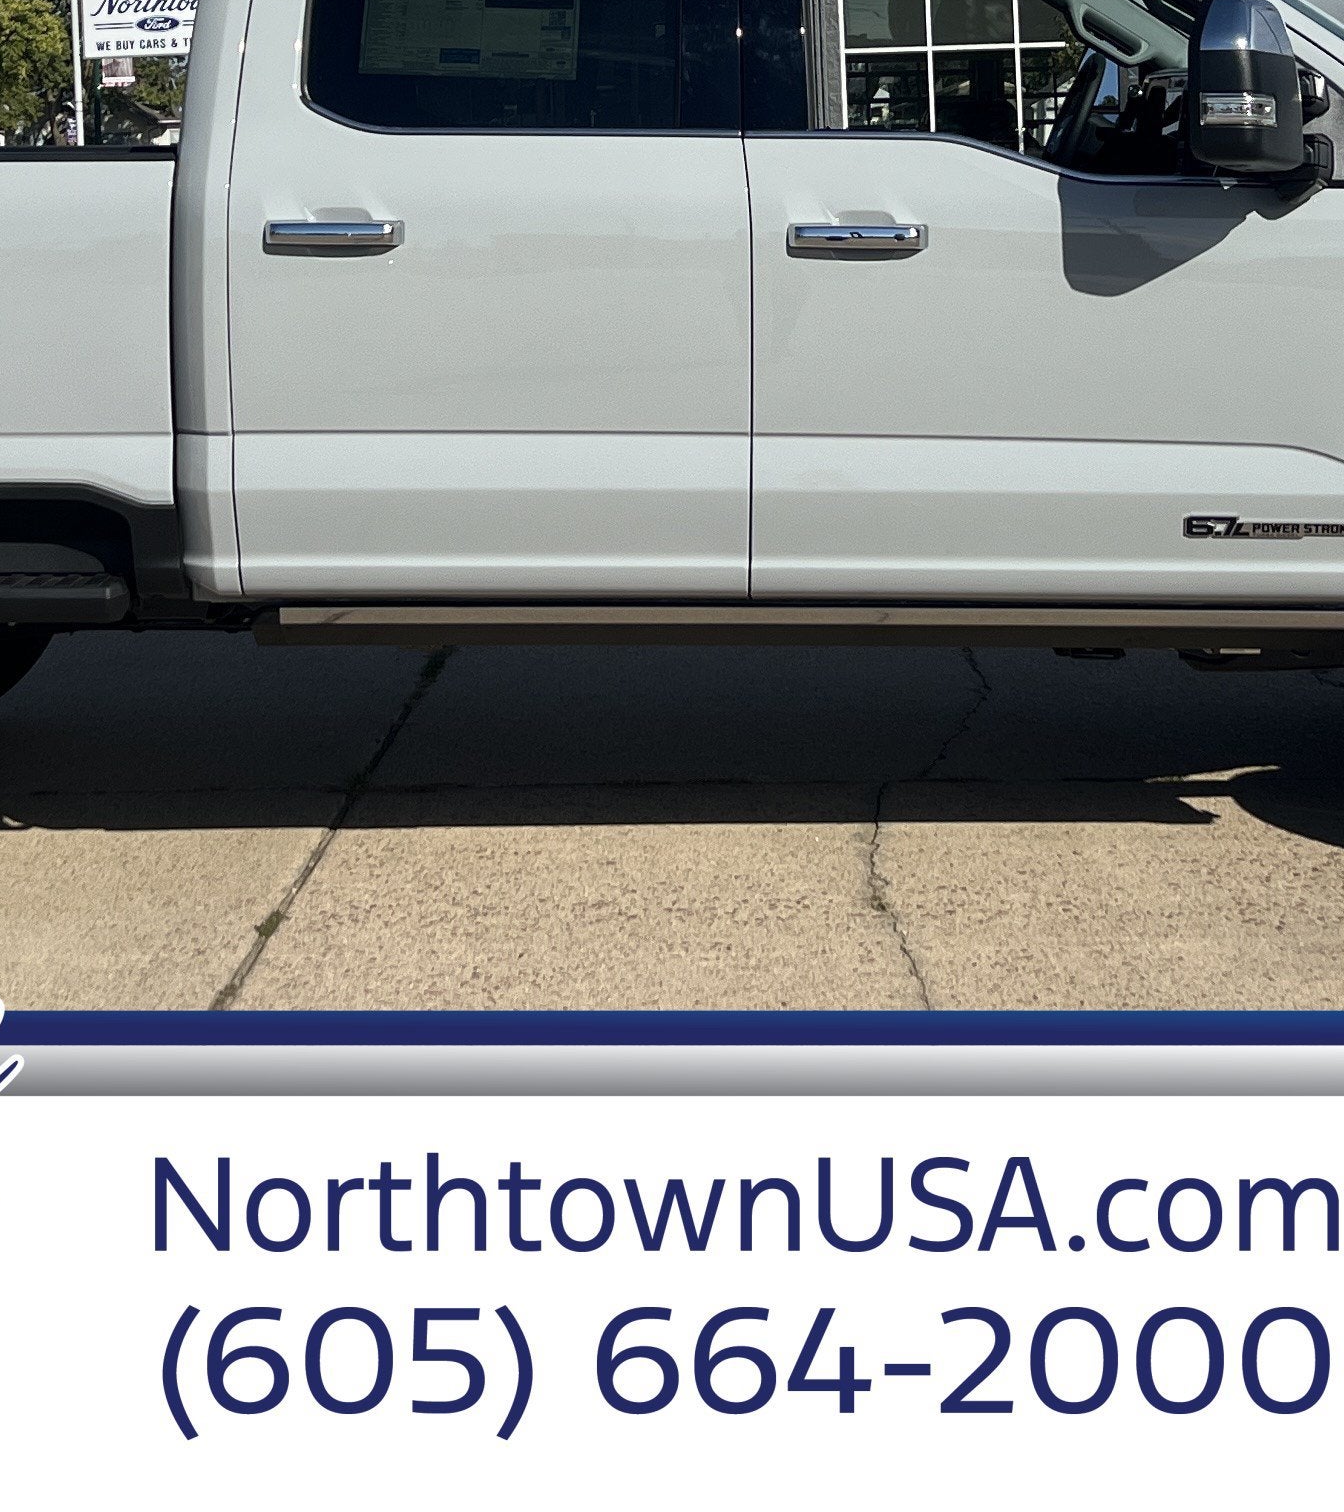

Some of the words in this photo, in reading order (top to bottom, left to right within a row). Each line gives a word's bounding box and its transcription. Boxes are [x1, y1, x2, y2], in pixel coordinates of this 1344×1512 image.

[143, 17, 171, 30] Ford
[96, 41, 112, 52] WE
[116, 40, 135, 51] BUY
[139, 38, 166, 50] CARS
[171, 38, 178, 48] &
[1186, 516, 1250, 537] 6.7L
[1252, 522, 1300, 534] POWER
